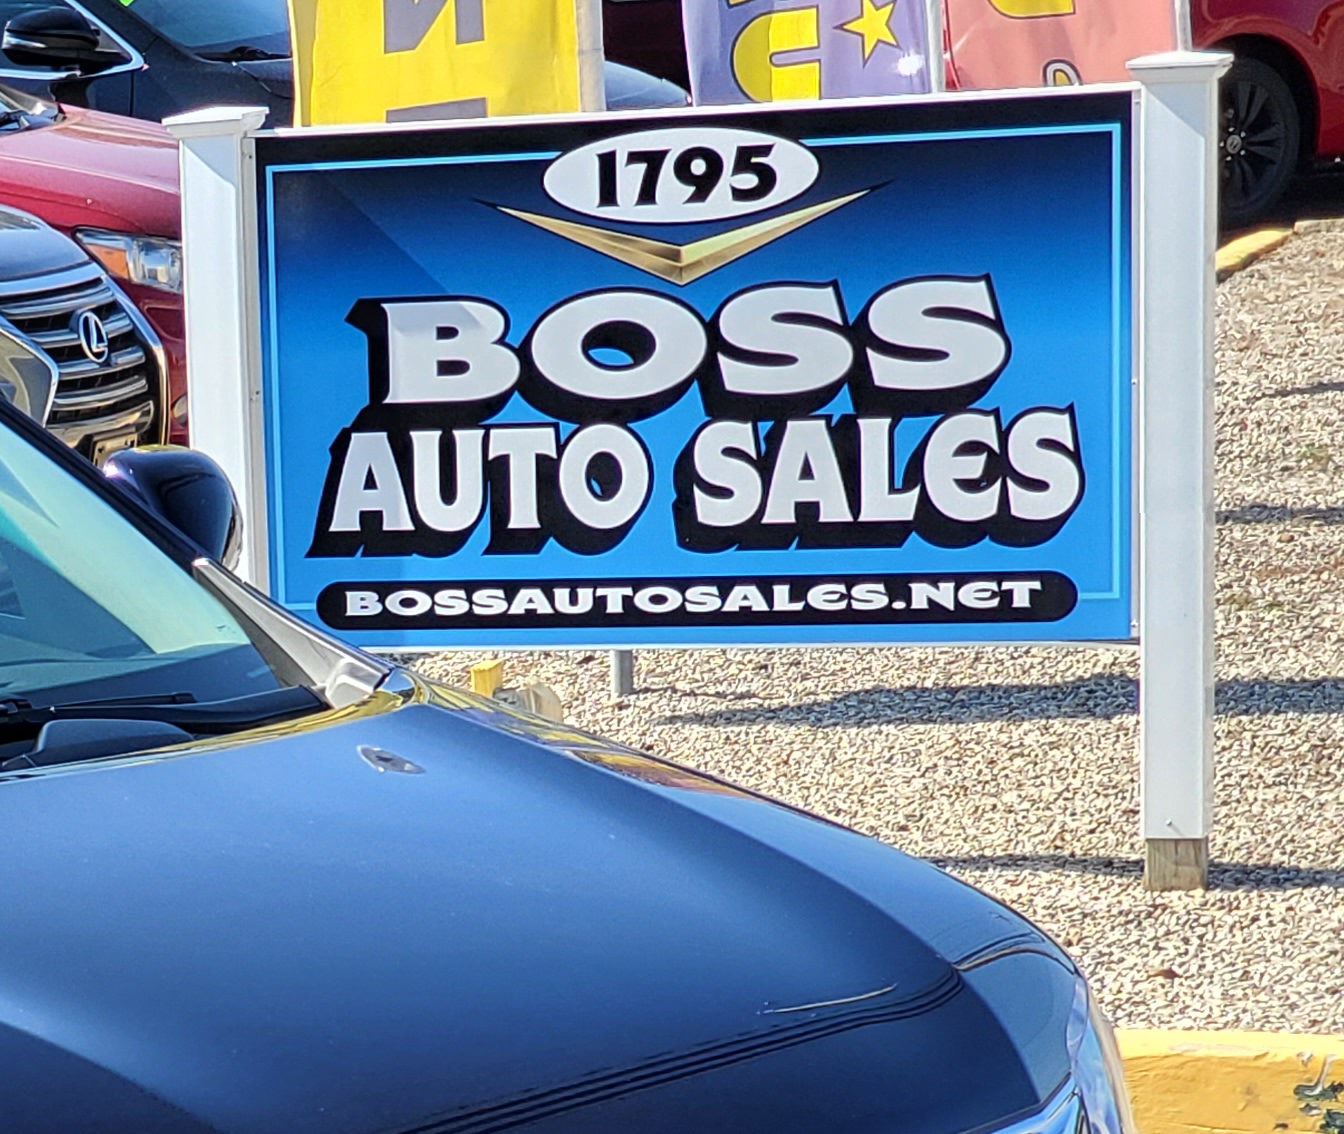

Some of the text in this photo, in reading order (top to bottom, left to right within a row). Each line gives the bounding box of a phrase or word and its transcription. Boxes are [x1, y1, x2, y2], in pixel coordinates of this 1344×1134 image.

[595, 142, 778, 209] 1795
[372, 275, 1010, 406] BOSS
[325, 406, 1082, 533] AUTO SALES
[343, 579, 1043, 619] BOSSAUTOSALES.NET
